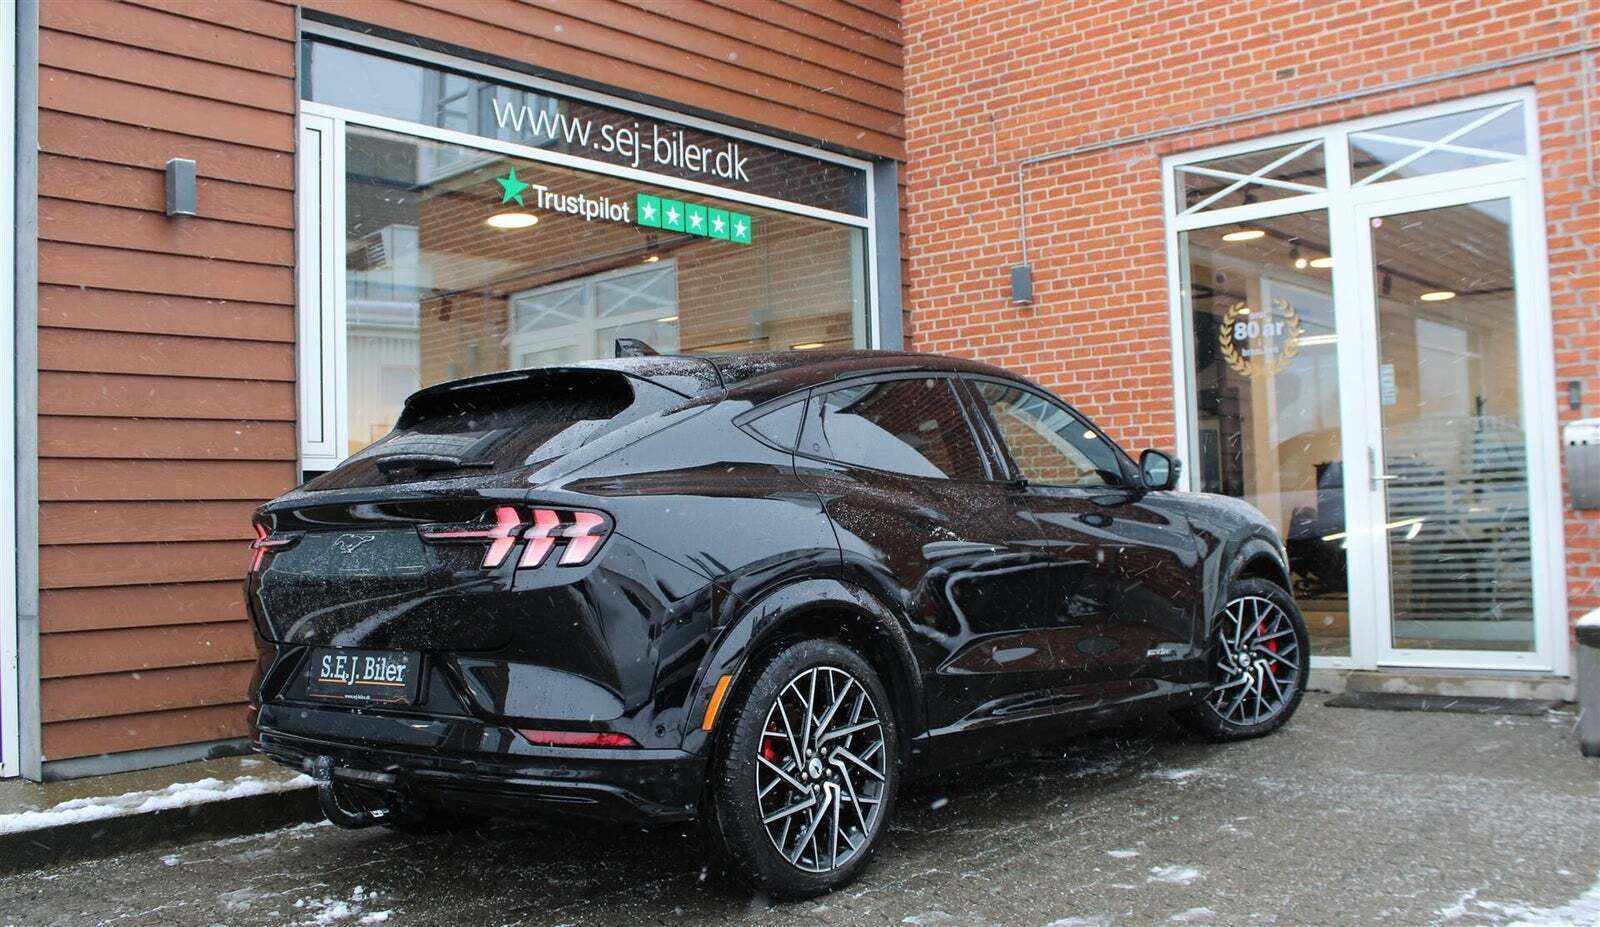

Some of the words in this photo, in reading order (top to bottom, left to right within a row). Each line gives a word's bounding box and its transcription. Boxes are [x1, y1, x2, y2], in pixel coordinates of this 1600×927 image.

[492, 99, 749, 182] www.sej-biler.dk
[532, 185, 630, 222] Trustpilot
[1234, 321, 1259, 340] 80
[320, 655, 360, 685] S.E.J.
[363, 656, 407, 681] Biler
